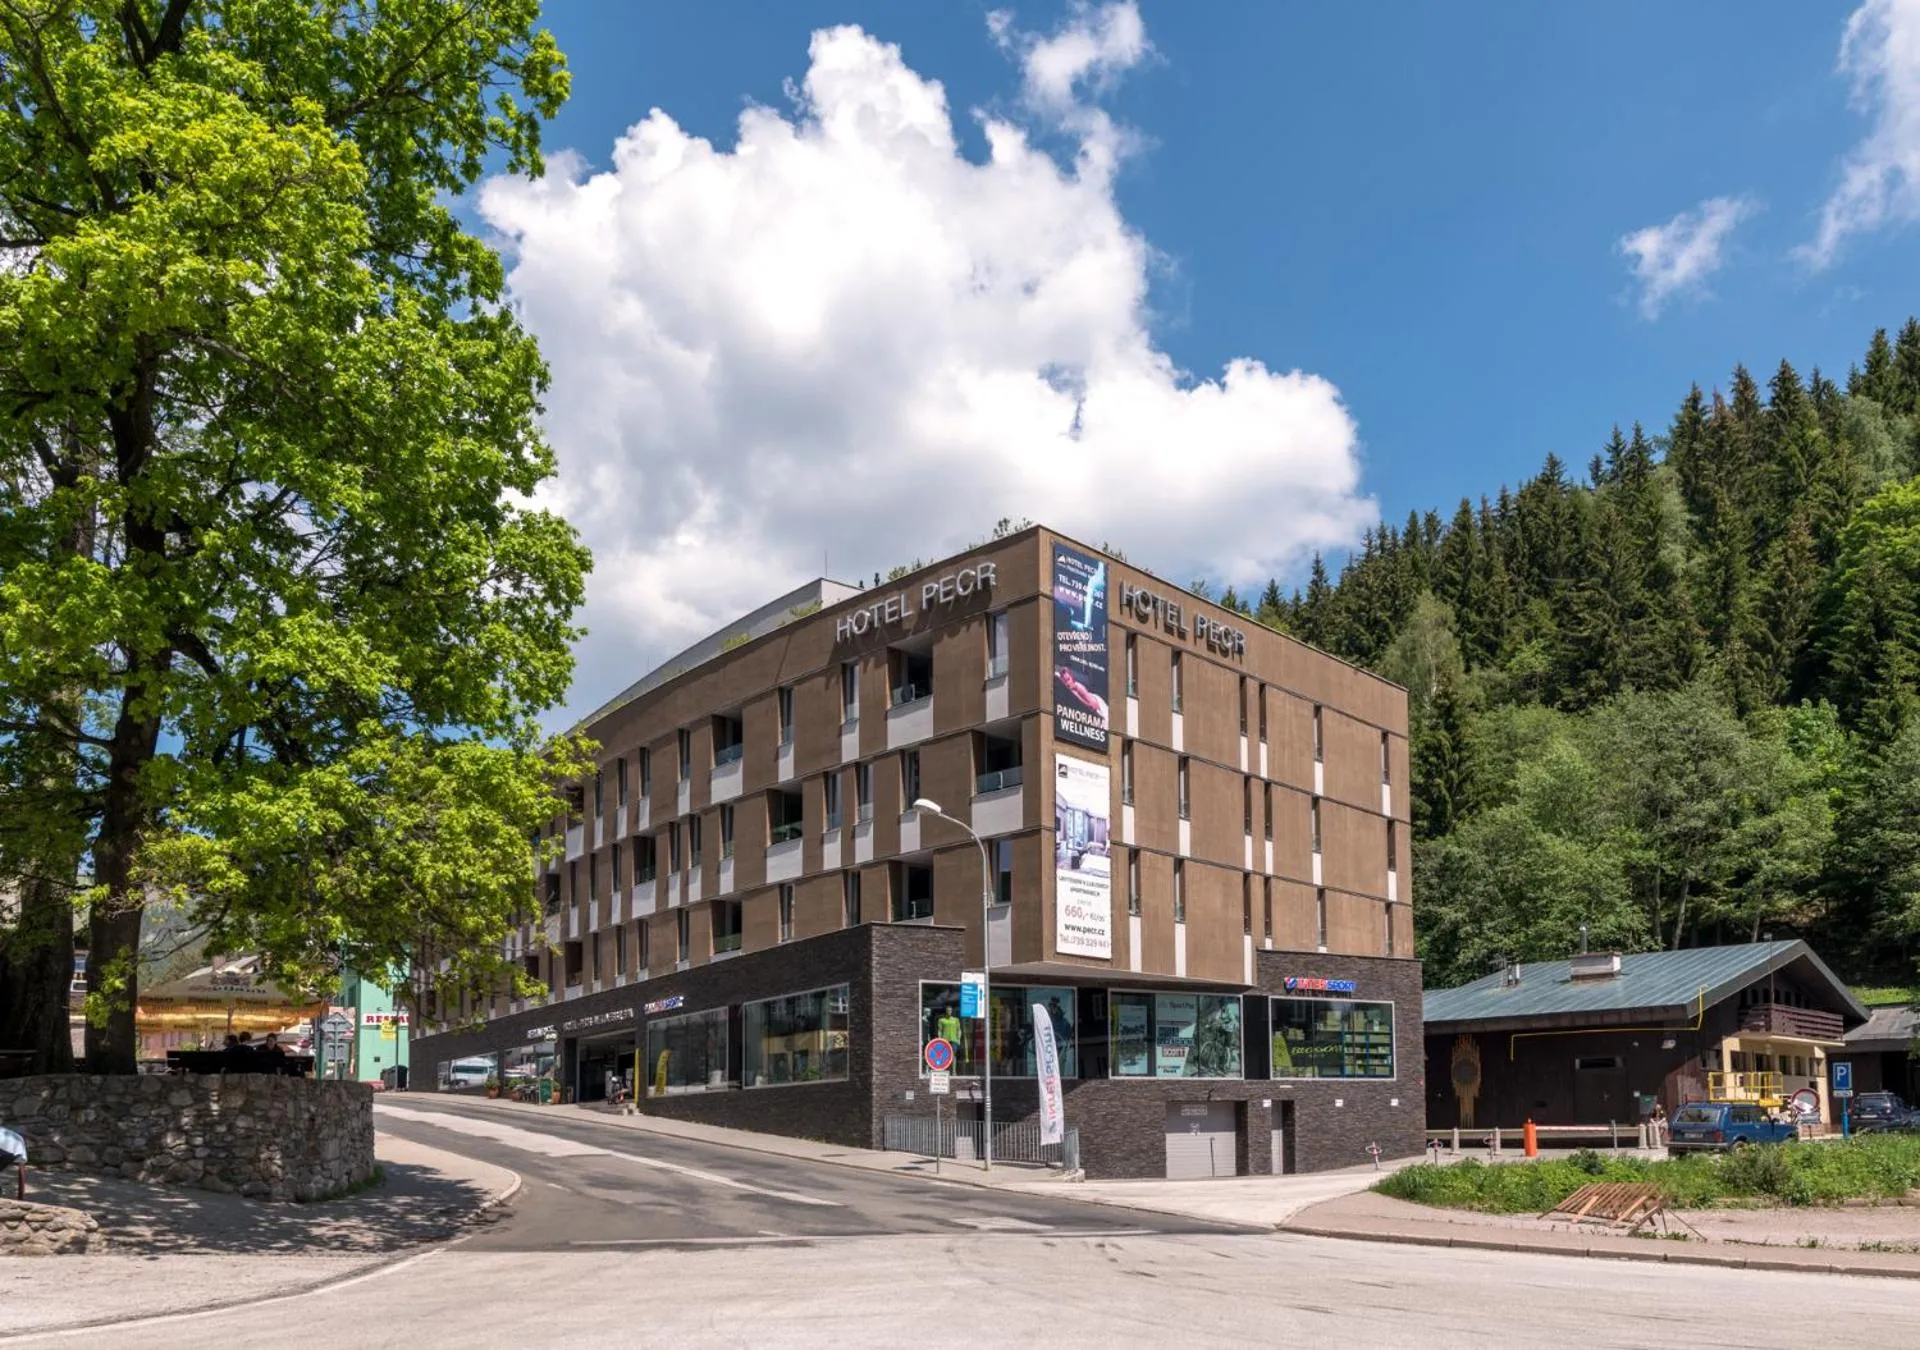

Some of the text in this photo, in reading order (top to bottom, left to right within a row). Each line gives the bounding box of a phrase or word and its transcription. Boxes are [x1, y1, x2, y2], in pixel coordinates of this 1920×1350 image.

[836, 562, 997, 642] HOTEL PECR
[1121, 579, 1245, 655] HOTEL PECR
[1056, 704, 1105, 730] PANORAMA
[1060, 718, 1106, 743] WELLNESS
[1064, 923, 1105, 936] www.pecr.cz
[1298, 978, 1357, 992] INTERSPORT
[1836, 1066, 1847, 1080] P
